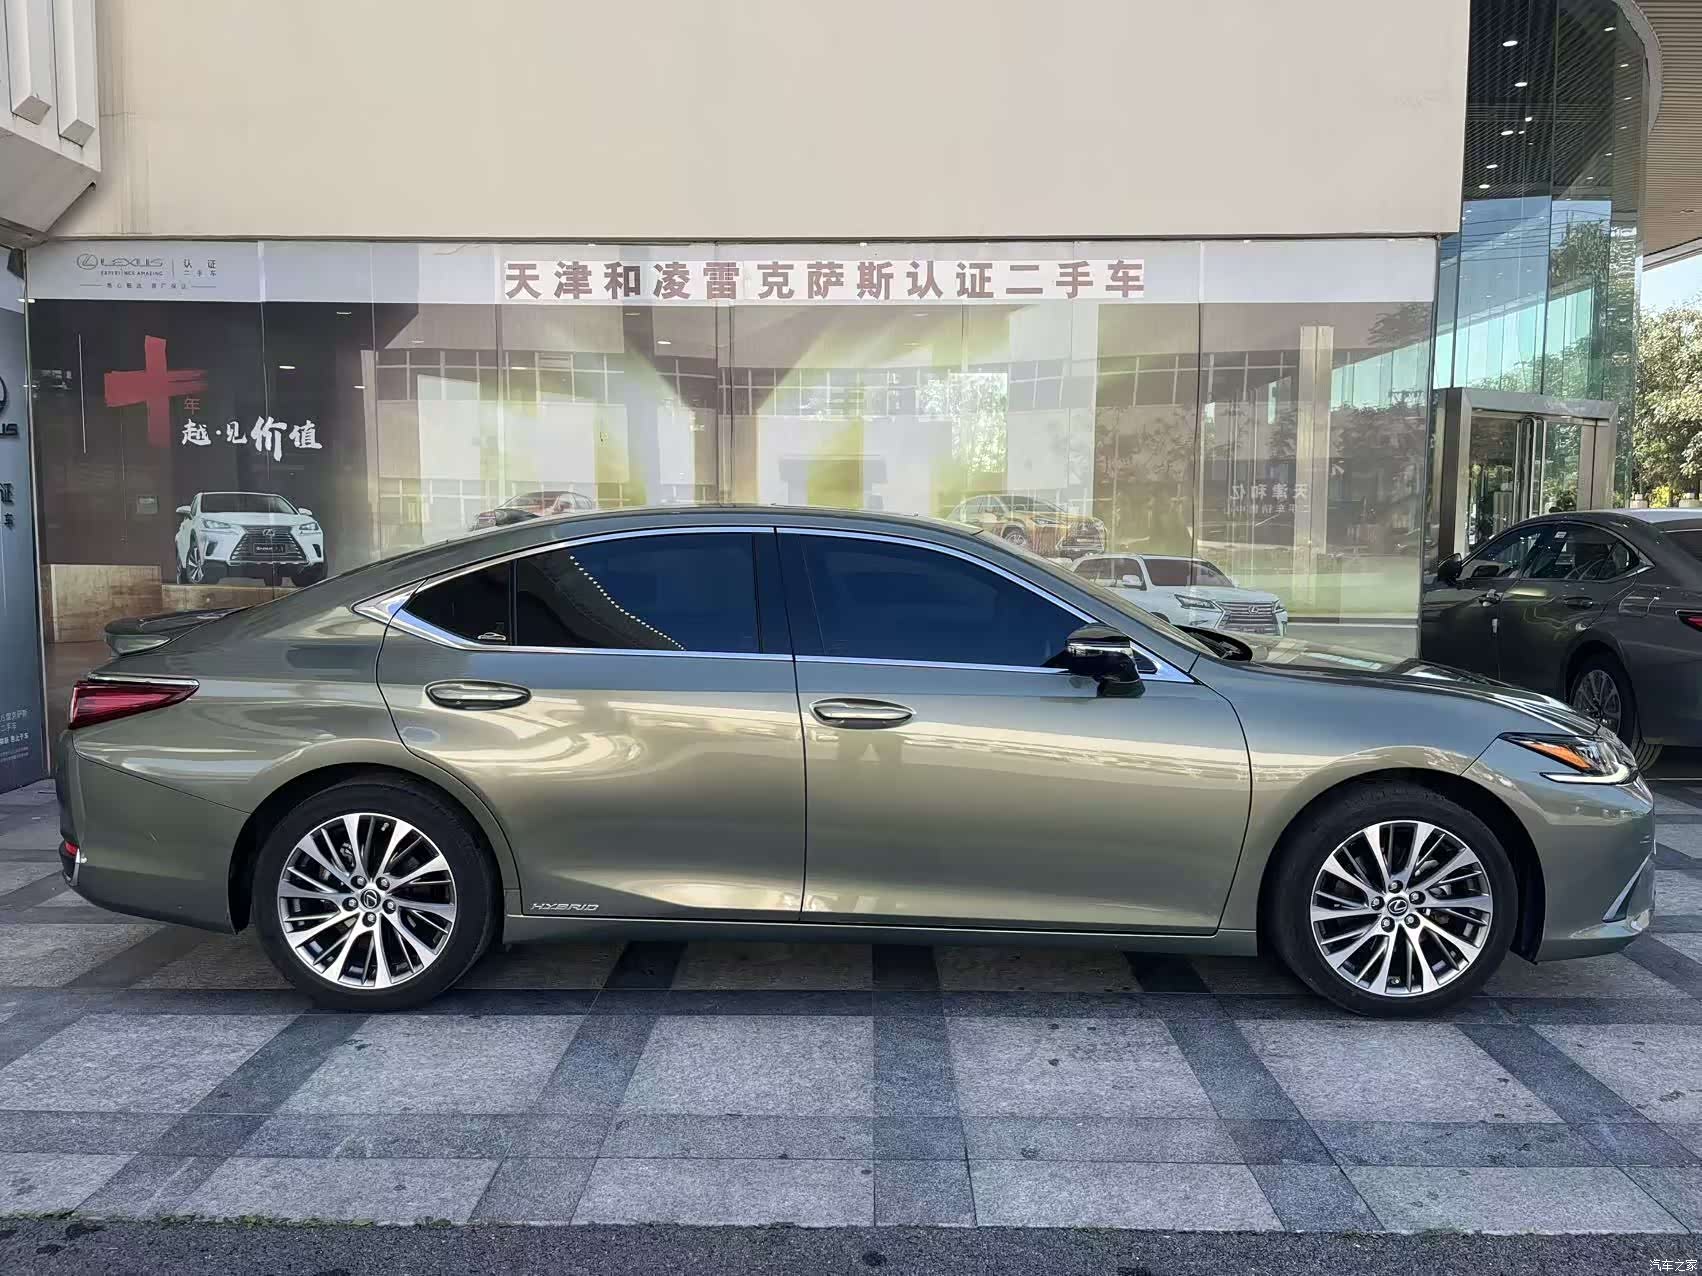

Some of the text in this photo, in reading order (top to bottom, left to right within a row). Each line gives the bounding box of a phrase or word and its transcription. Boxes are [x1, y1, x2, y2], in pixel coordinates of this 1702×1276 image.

[101, 257, 163, 267] LEXUS
[183, 258, 217, 269] 认证
[504, 260, 1145, 299] 天津和凌雷克萨斯认证二手车
[530, 903, 599, 911] HYBRID
